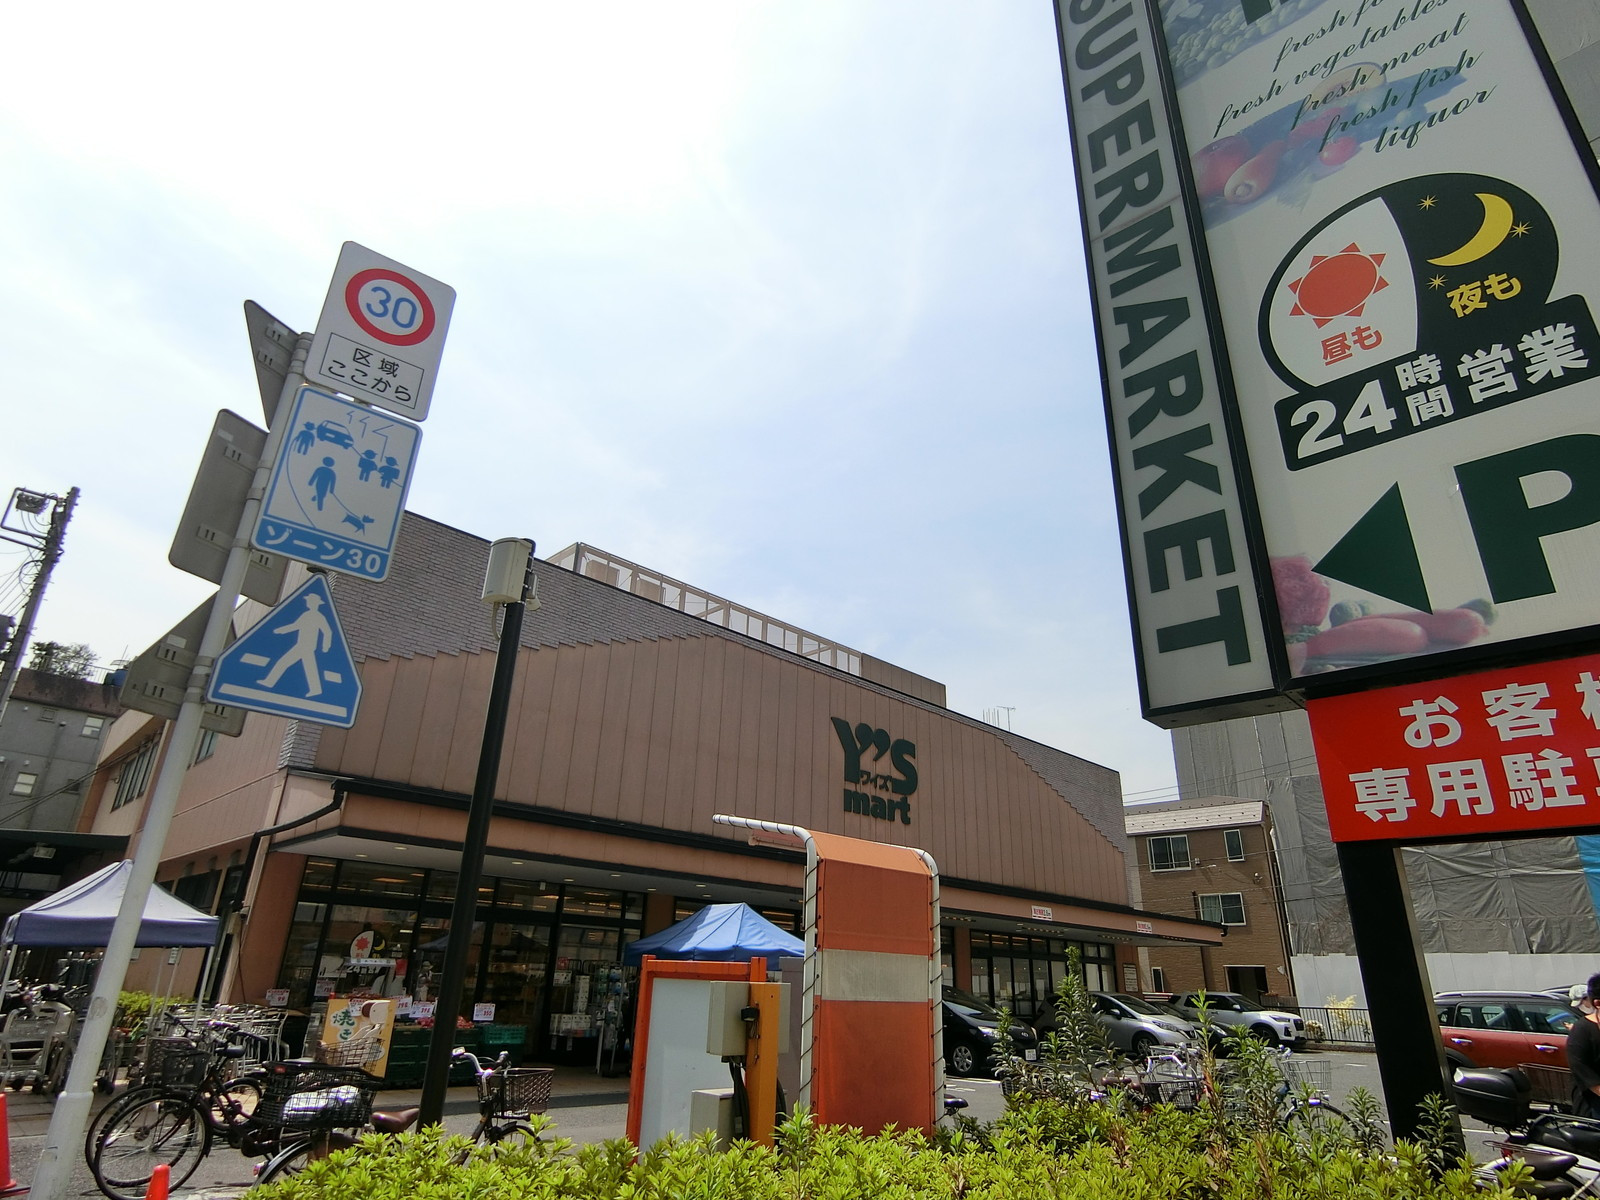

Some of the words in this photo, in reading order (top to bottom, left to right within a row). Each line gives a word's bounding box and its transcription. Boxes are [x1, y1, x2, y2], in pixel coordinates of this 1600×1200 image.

[1273, 9, 1353, 72] fresh
[1291, 66, 1375, 131] fresh
[1380, 12, 1470, 76] meat
[1213, 79, 1289, 138] fresh
[1319, 87, 1407, 152] fresh
[1407, 49, 1484, 108] fish
[1374, 85, 1497, 153] liquor
[366, 286, 417, 329] 30
[1447, 272, 1522, 318] 夜も
[352, 348, 399, 378] 区域
[1321, 325, 1383, 366] 昼も
[328, 359, 412, 402] ここから
[1453, 433, 1600, 605] P
[265, 525, 381, 574] ゾーン30
[843, 788, 911, 825] mart
[1348, 746, 1600, 824] 専用駐
